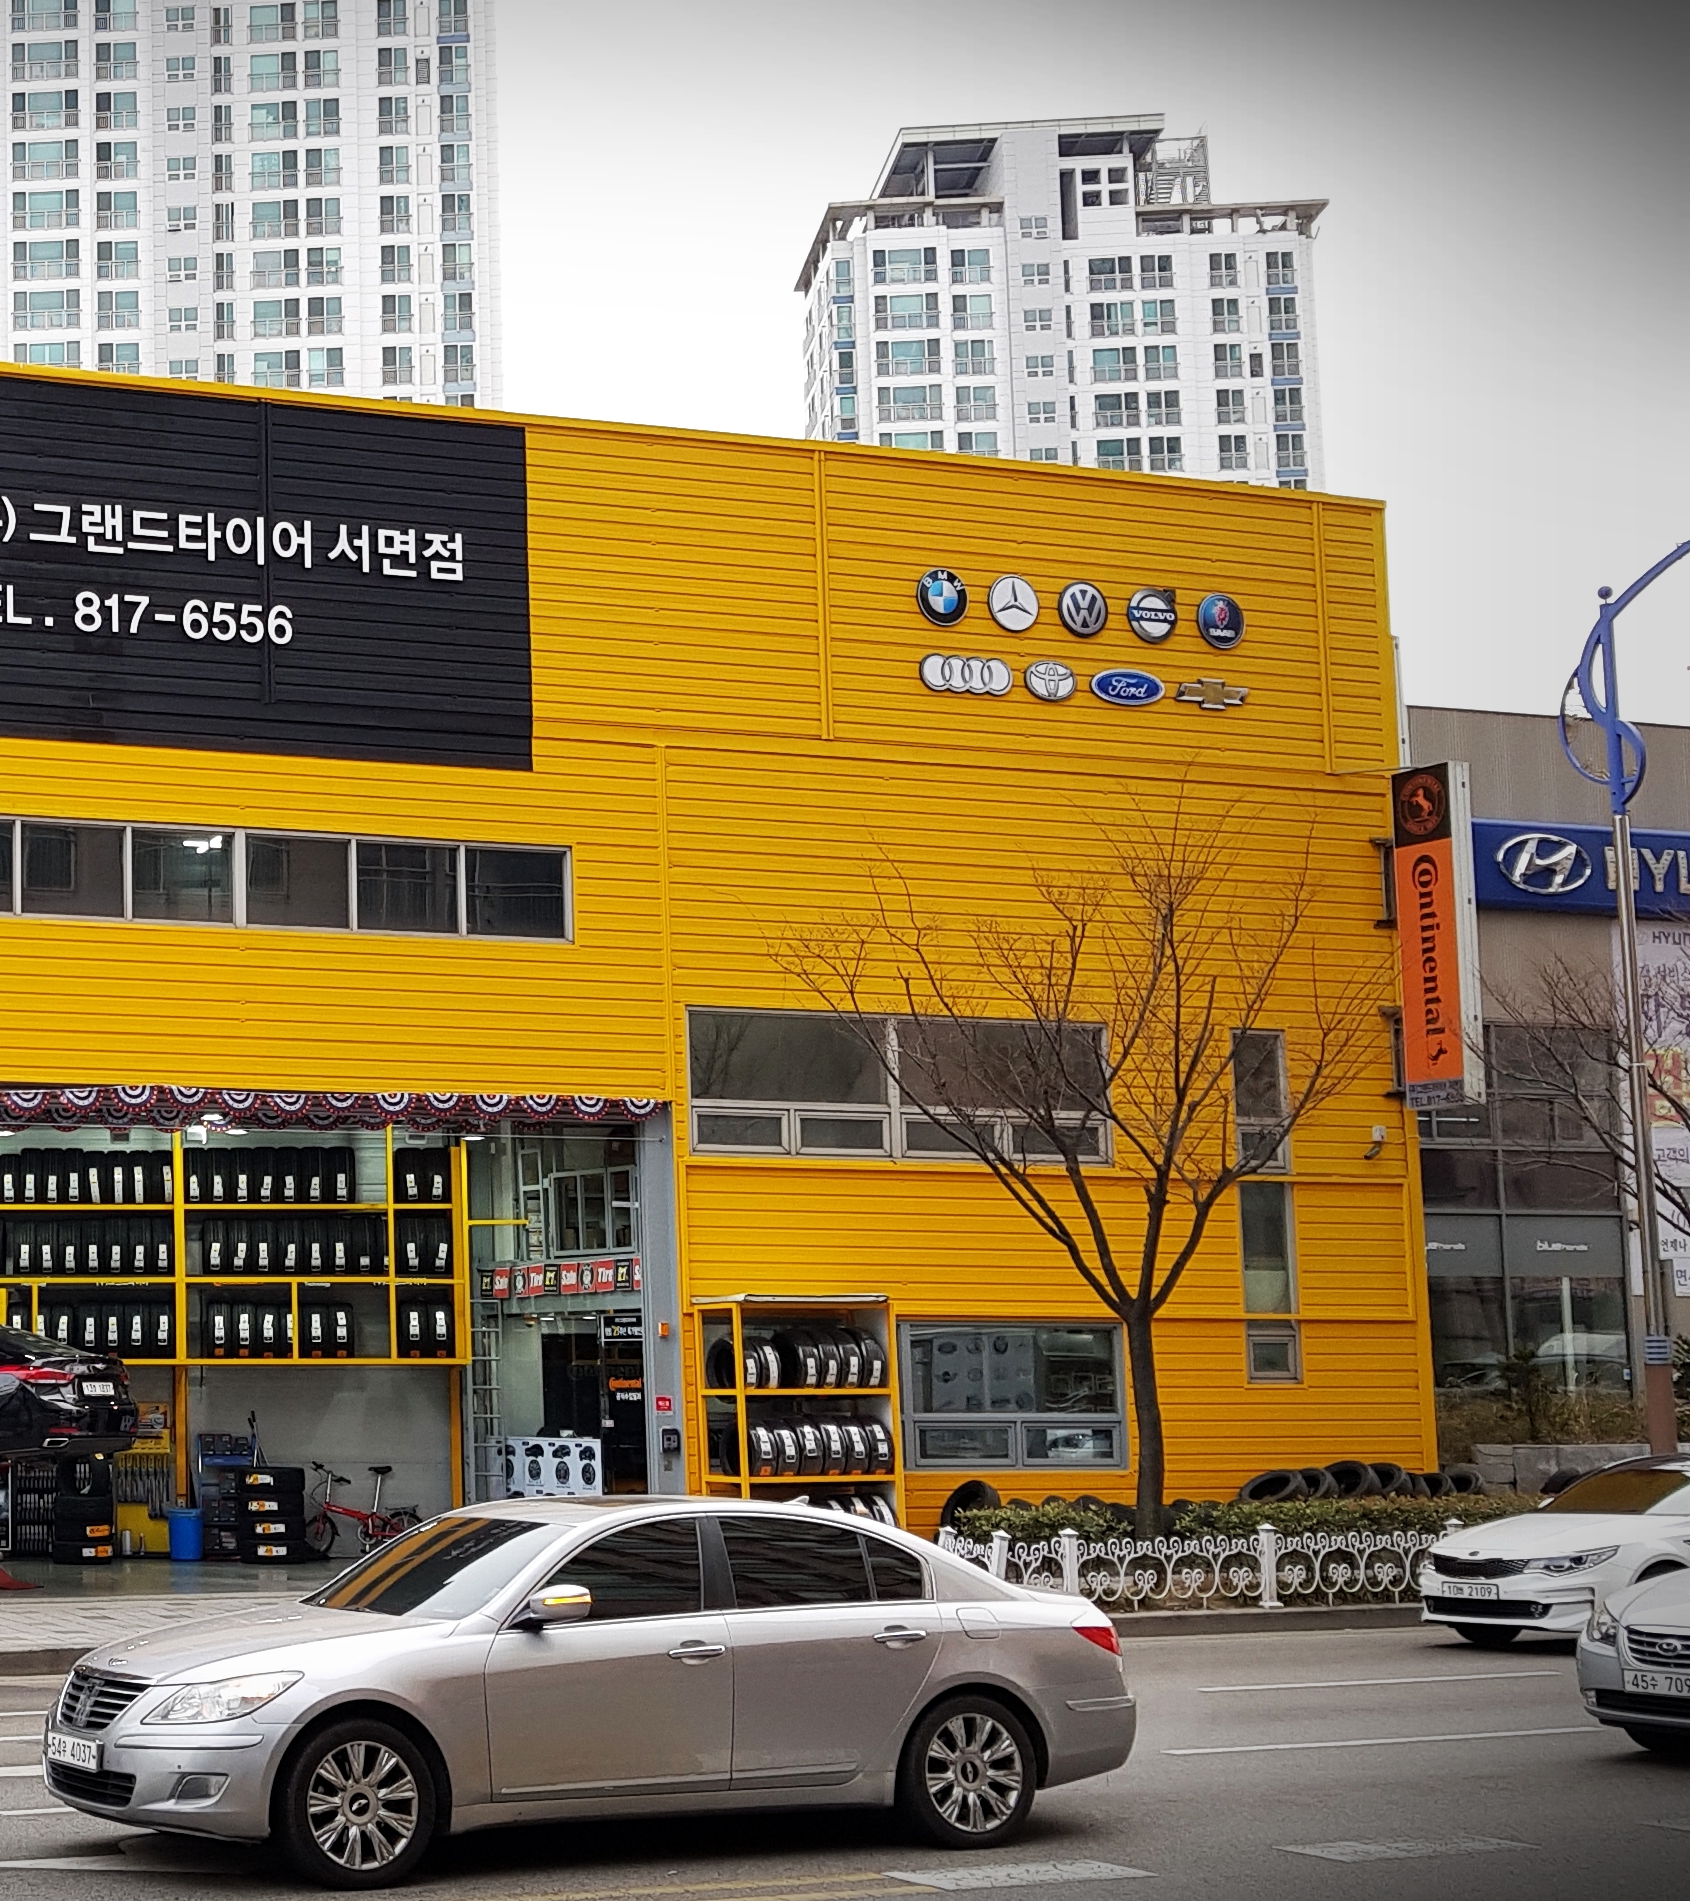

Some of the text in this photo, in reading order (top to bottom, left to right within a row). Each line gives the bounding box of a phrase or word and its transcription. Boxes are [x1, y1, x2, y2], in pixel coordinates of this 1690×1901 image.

[28, 502, 312, 570] 그랜드타이어
[327, 522, 465, 583] 서면점
[923, 569, 966, 592] BMW
[73, 590, 294, 646] 817-6556
[1131, 608, 1176, 622] VOLVO
[1110, 676, 1149, 698] Ford
[1411, 854, 1446, 1040] Continental
[1467, 1585, 1493, 1598] 2109
[1631, 1673, 1659, 1691] 45수
[70, 1740, 92, 1765] 4037
